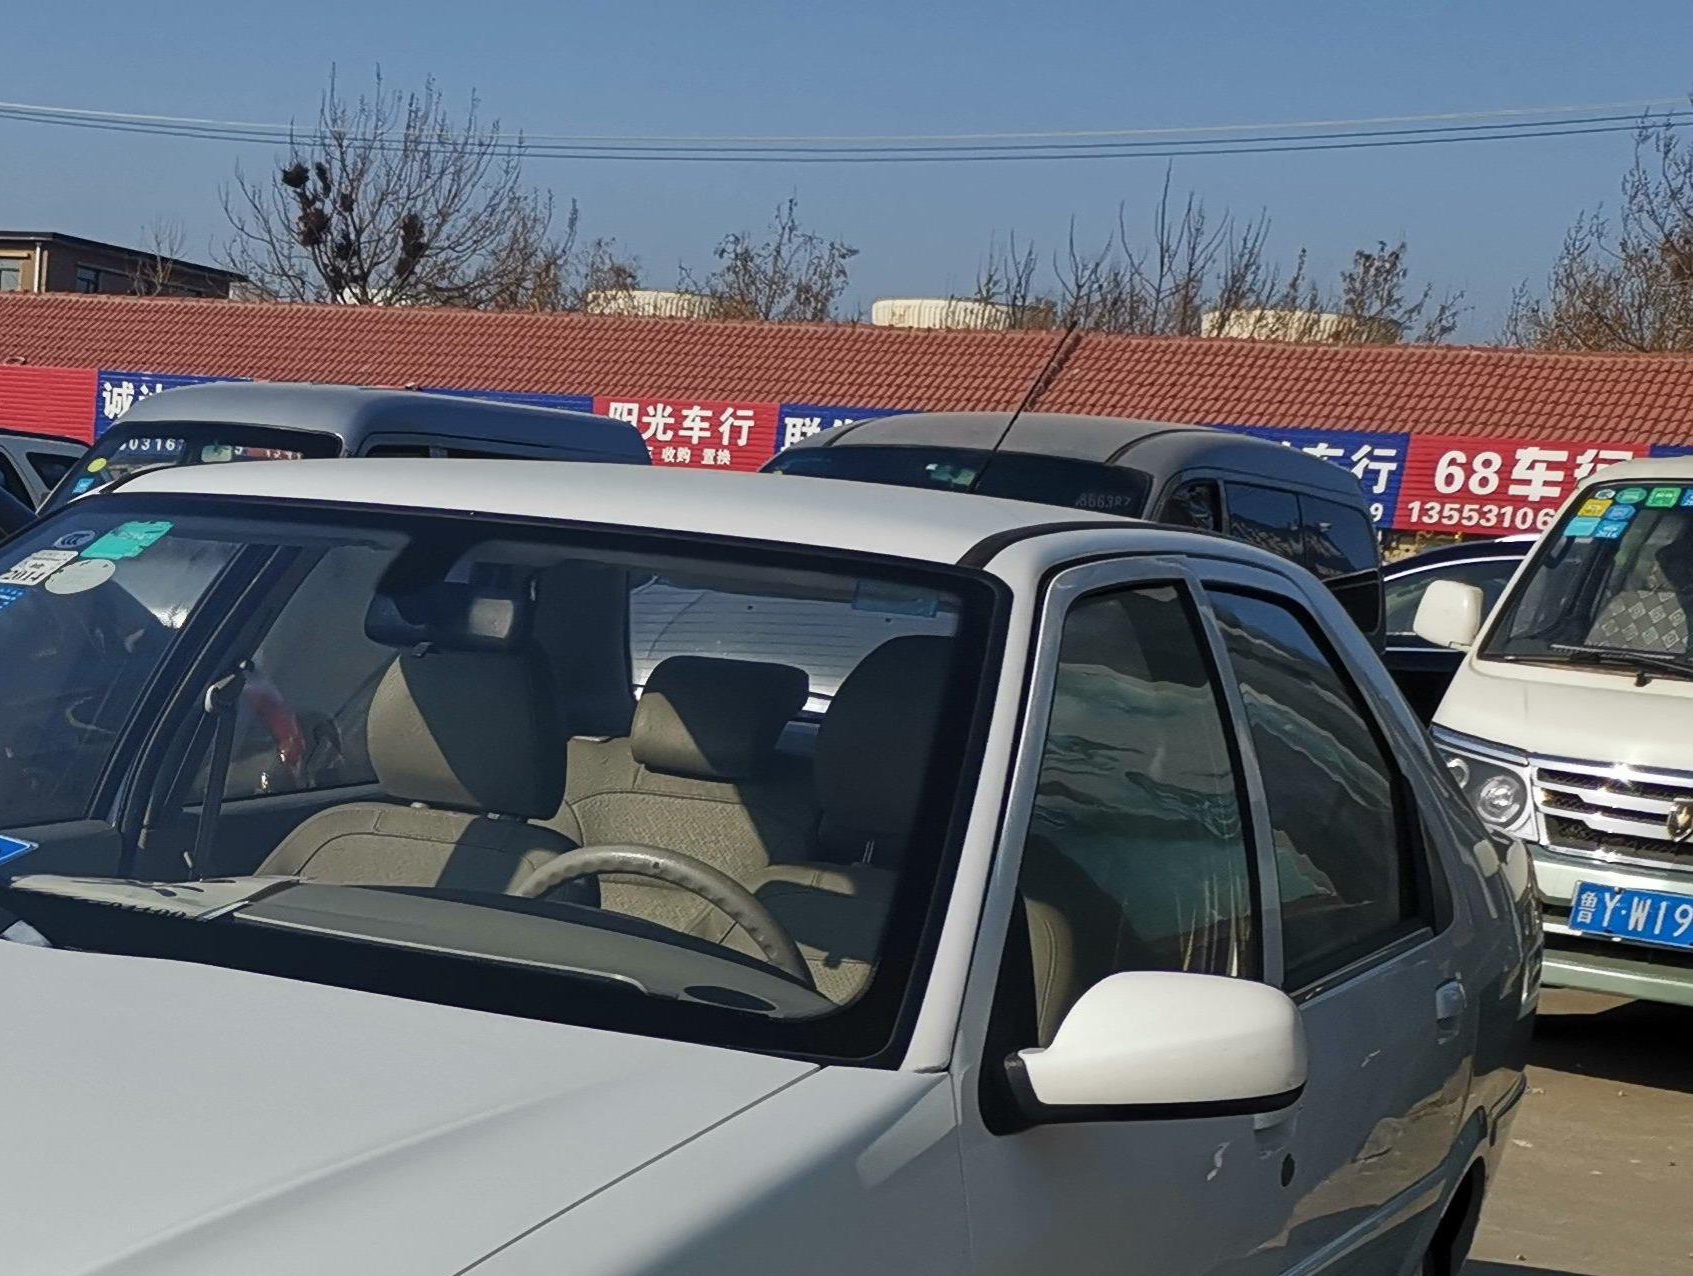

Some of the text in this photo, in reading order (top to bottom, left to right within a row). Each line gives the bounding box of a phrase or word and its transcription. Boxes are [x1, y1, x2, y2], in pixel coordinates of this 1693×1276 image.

[102, 381, 163, 419] 诚
[608, 401, 755, 446] 阳光车行
[783, 416, 853, 445] 联
[661, 447, 691, 463] 收购
[701, 448, 731, 465] 置换
[1408, 501, 1555, 530] 13553106
